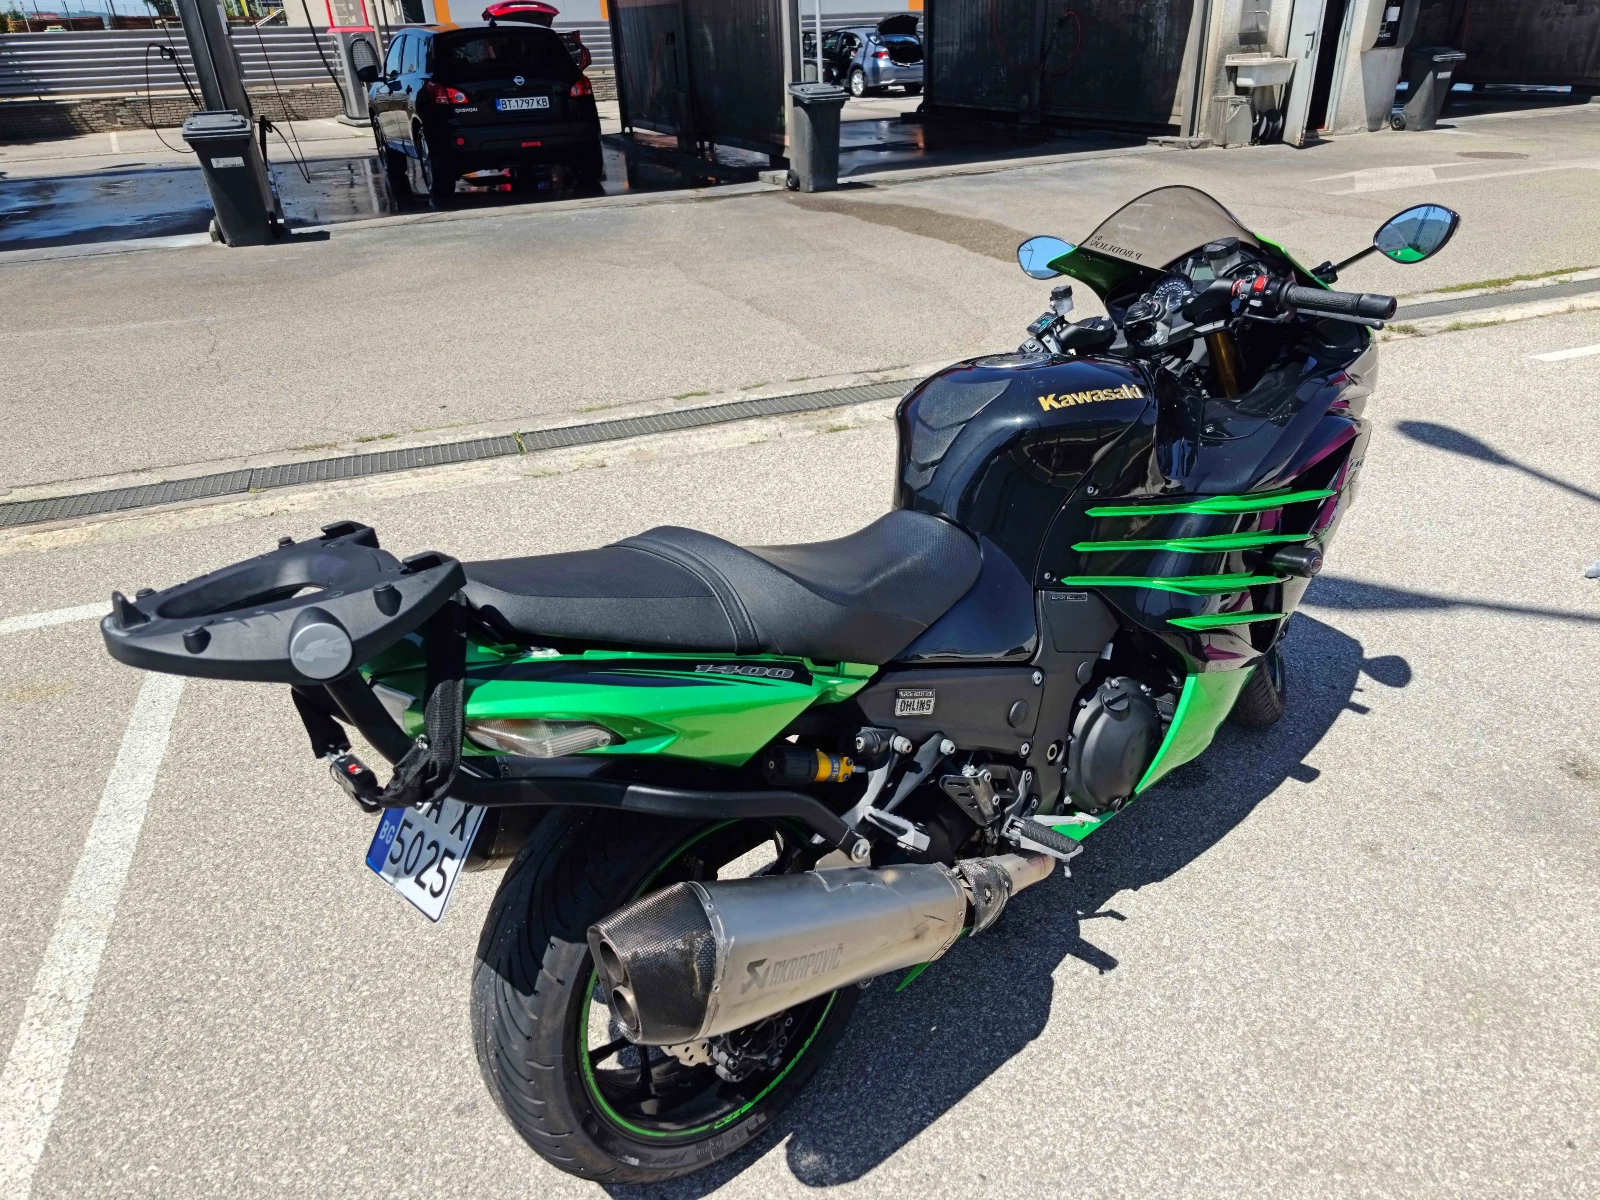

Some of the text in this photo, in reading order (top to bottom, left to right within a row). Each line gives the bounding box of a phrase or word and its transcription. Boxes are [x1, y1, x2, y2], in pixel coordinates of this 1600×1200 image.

[515, 98, 535, 108] 1797
[536, 97, 548, 107] KB
[1038, 384, 1144, 411] Kawasaki
[695, 664, 794, 679] 1400
[378, 821, 395, 845] BG
[450, 803, 474, 842] X
[389, 819, 456, 898] 5025
